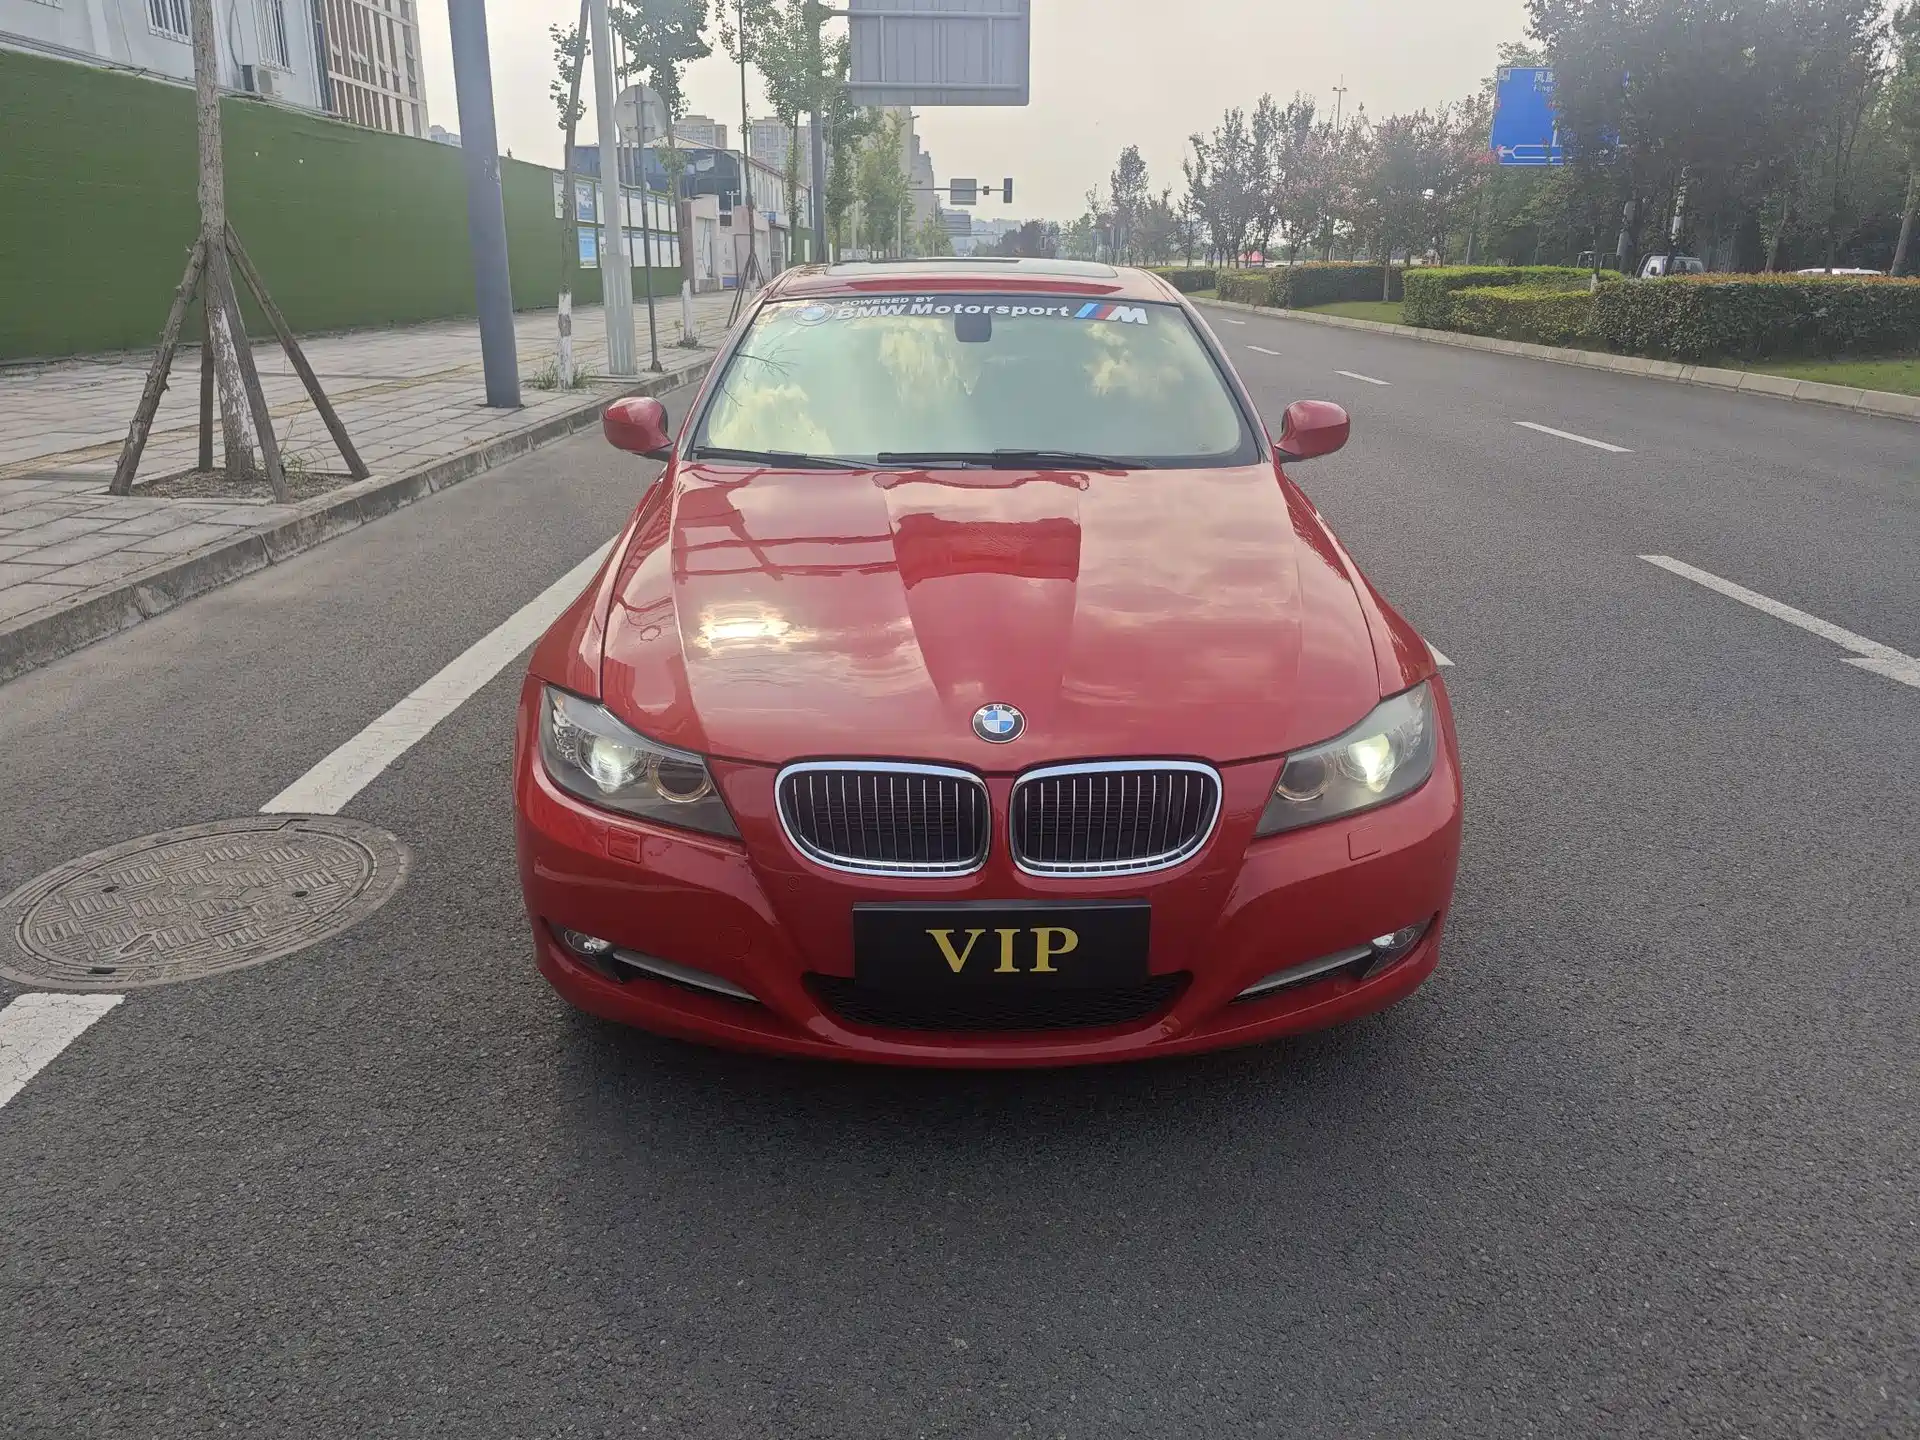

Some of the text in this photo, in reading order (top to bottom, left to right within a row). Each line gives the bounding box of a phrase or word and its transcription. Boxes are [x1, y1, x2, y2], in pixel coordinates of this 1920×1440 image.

[841, 297, 909, 306] POWERED
[836, 303, 905, 320] BMW
[909, 303, 1069, 318] Motorsport
[977, 704, 1021, 716] BMW
[925, 927, 1079, 973] VIP
